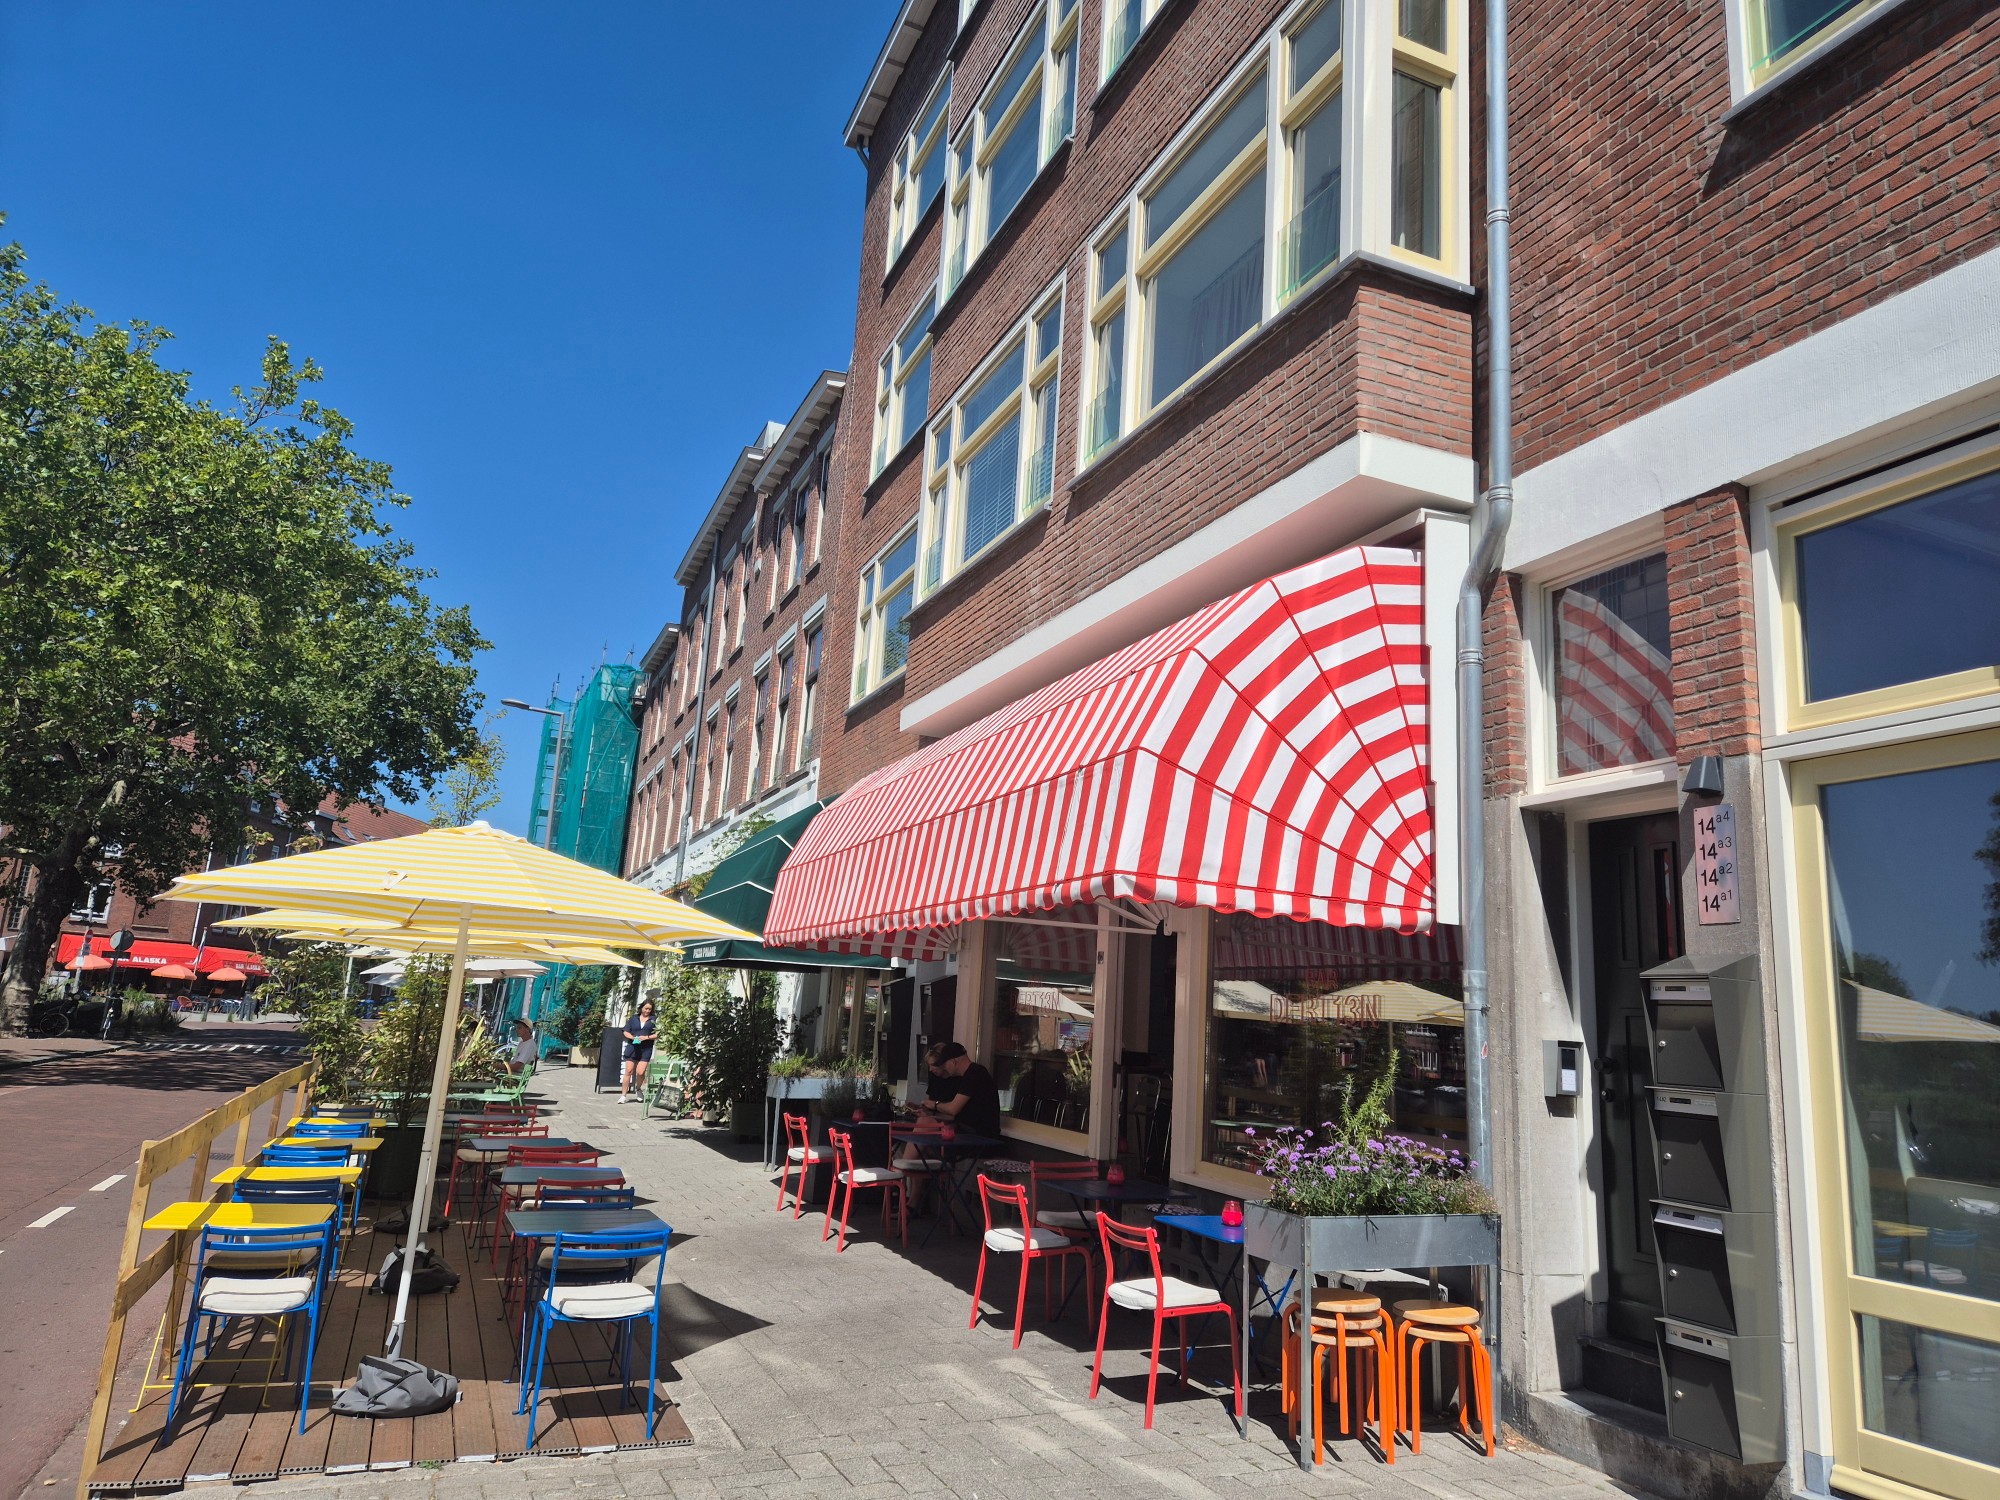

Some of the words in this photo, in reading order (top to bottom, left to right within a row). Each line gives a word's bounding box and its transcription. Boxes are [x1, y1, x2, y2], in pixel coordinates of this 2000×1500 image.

[132, 956, 167, 965] ALASKA
[1306, 968, 1339, 991] BAR
[1270, 993, 1381, 1028] DERT13N
